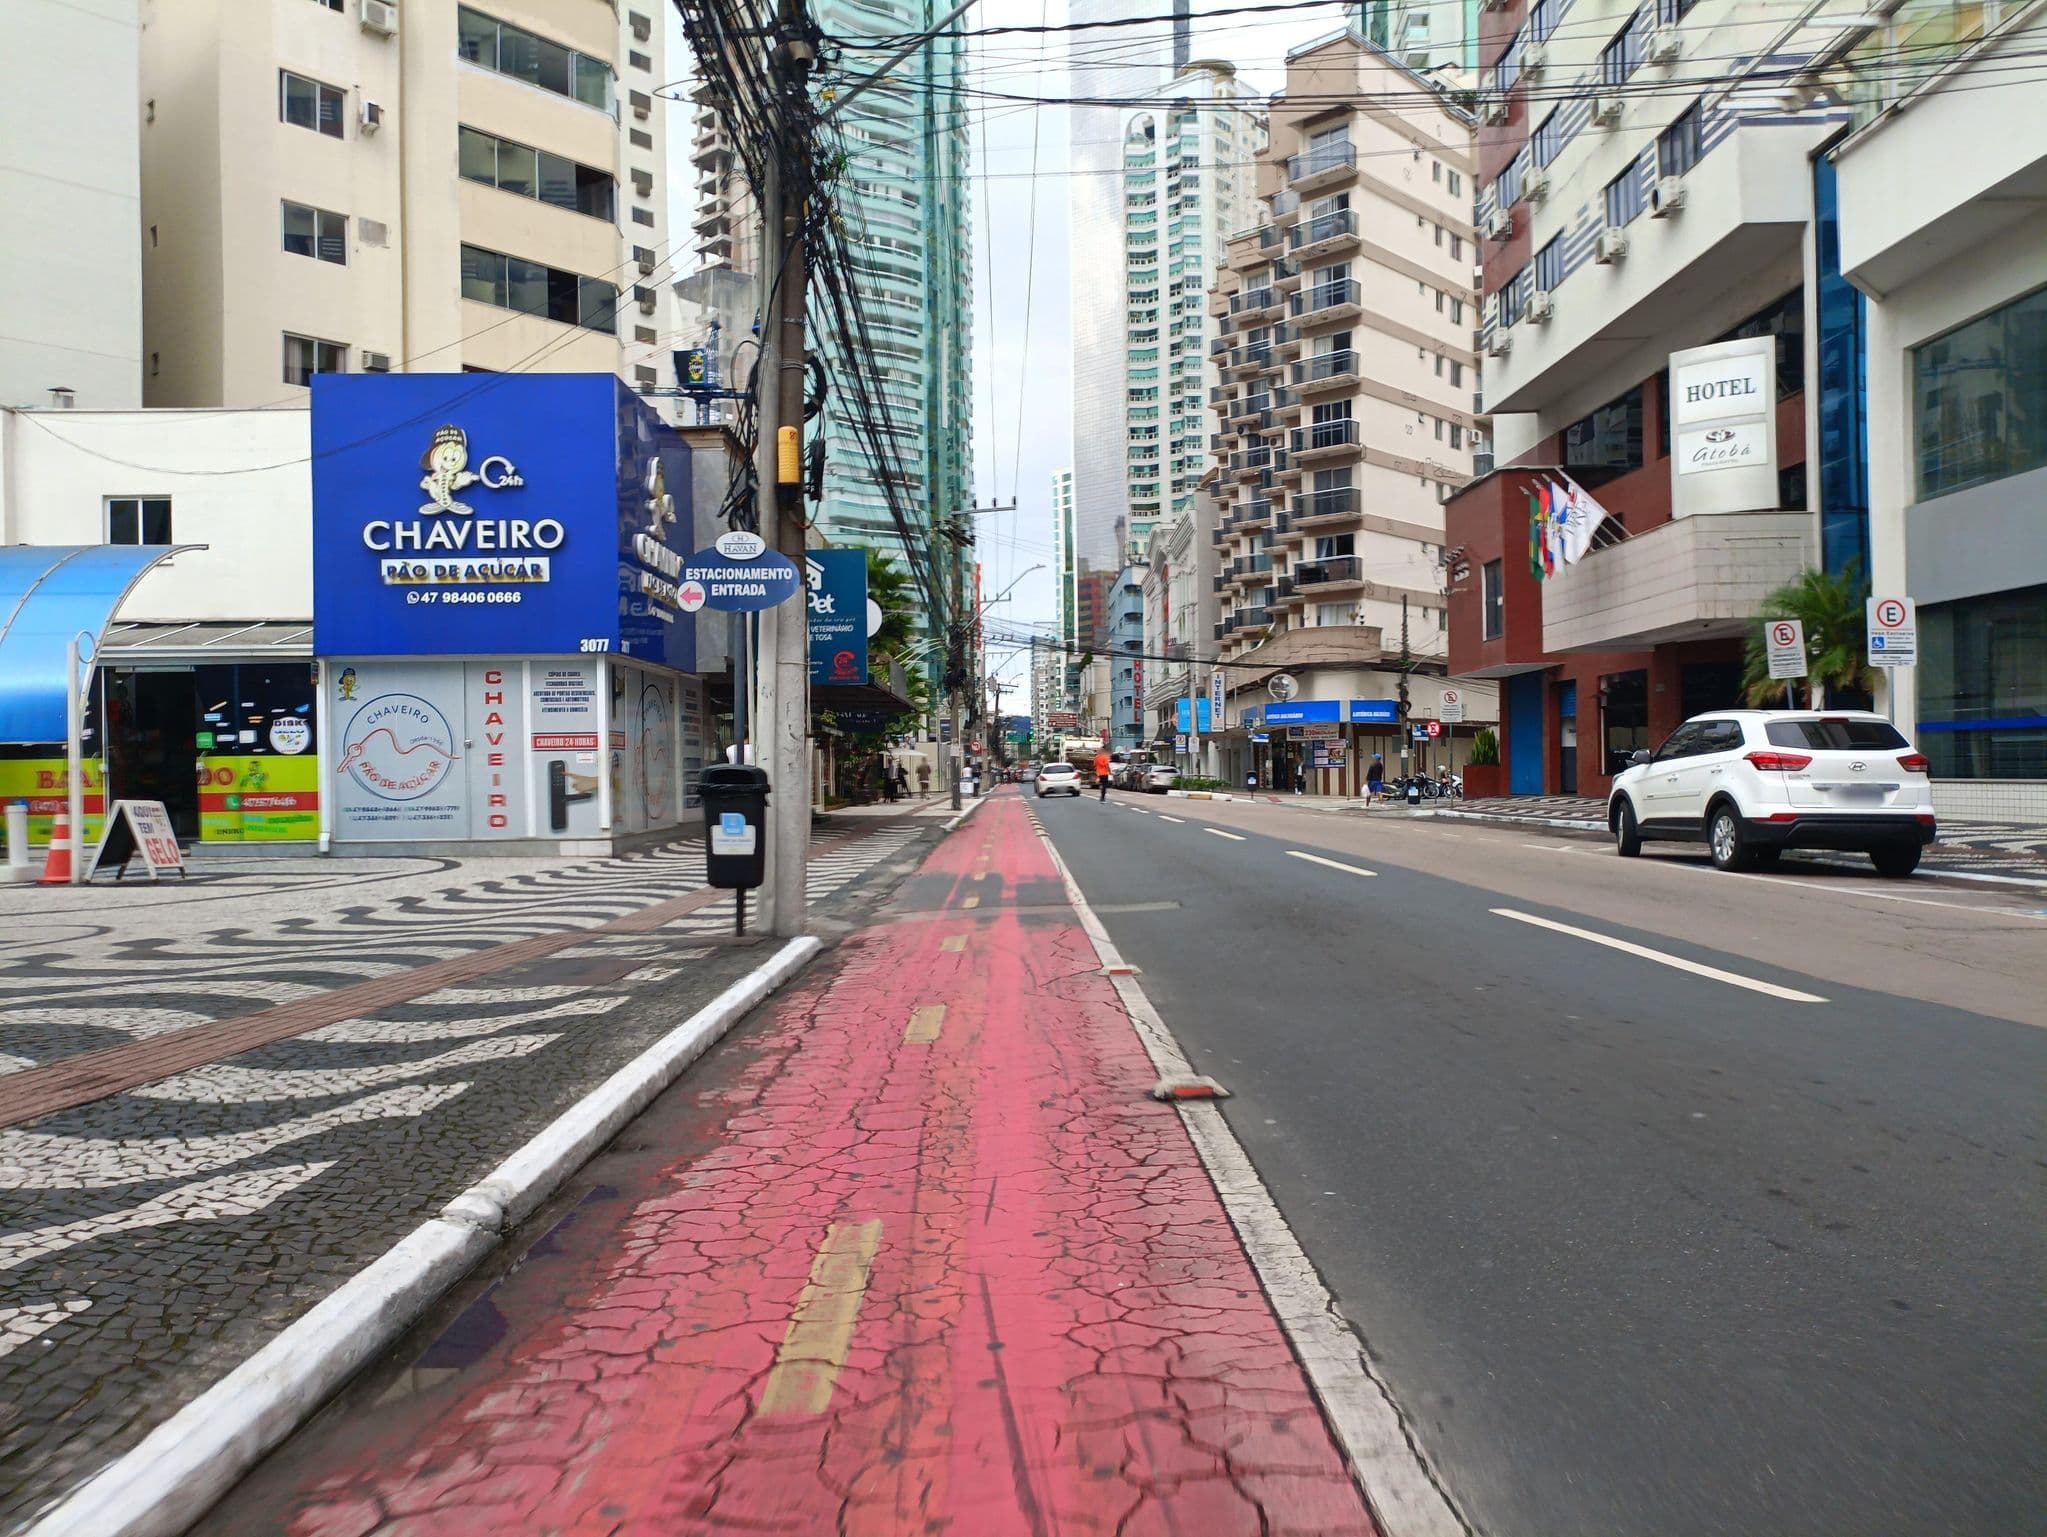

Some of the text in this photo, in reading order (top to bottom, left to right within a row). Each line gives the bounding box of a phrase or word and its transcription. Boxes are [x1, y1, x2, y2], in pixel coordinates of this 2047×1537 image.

[1686, 377, 1756, 403] HOTEL
[498, 475, 524, 487] 24h
[363, 518, 565, 550] CHAVEIRO
[387, 561, 428, 578] PÃO
[434, 564, 460, 578] DE
[686, 567, 793, 580] ESTACIONAMENTO
[421, 591, 521, 603] 47 98406 0666
[711, 584, 766, 596] ENTRADA
[1886, 607, 1897, 622] E
[580, 638, 609, 652] 3077
[1133, 659, 1143, 722] HOTEL
[367, 705, 429, 724] CHAVEIRO
[485, 670, 508, 828] CHAVEIRO
[144, 838, 180, 865] GELO
